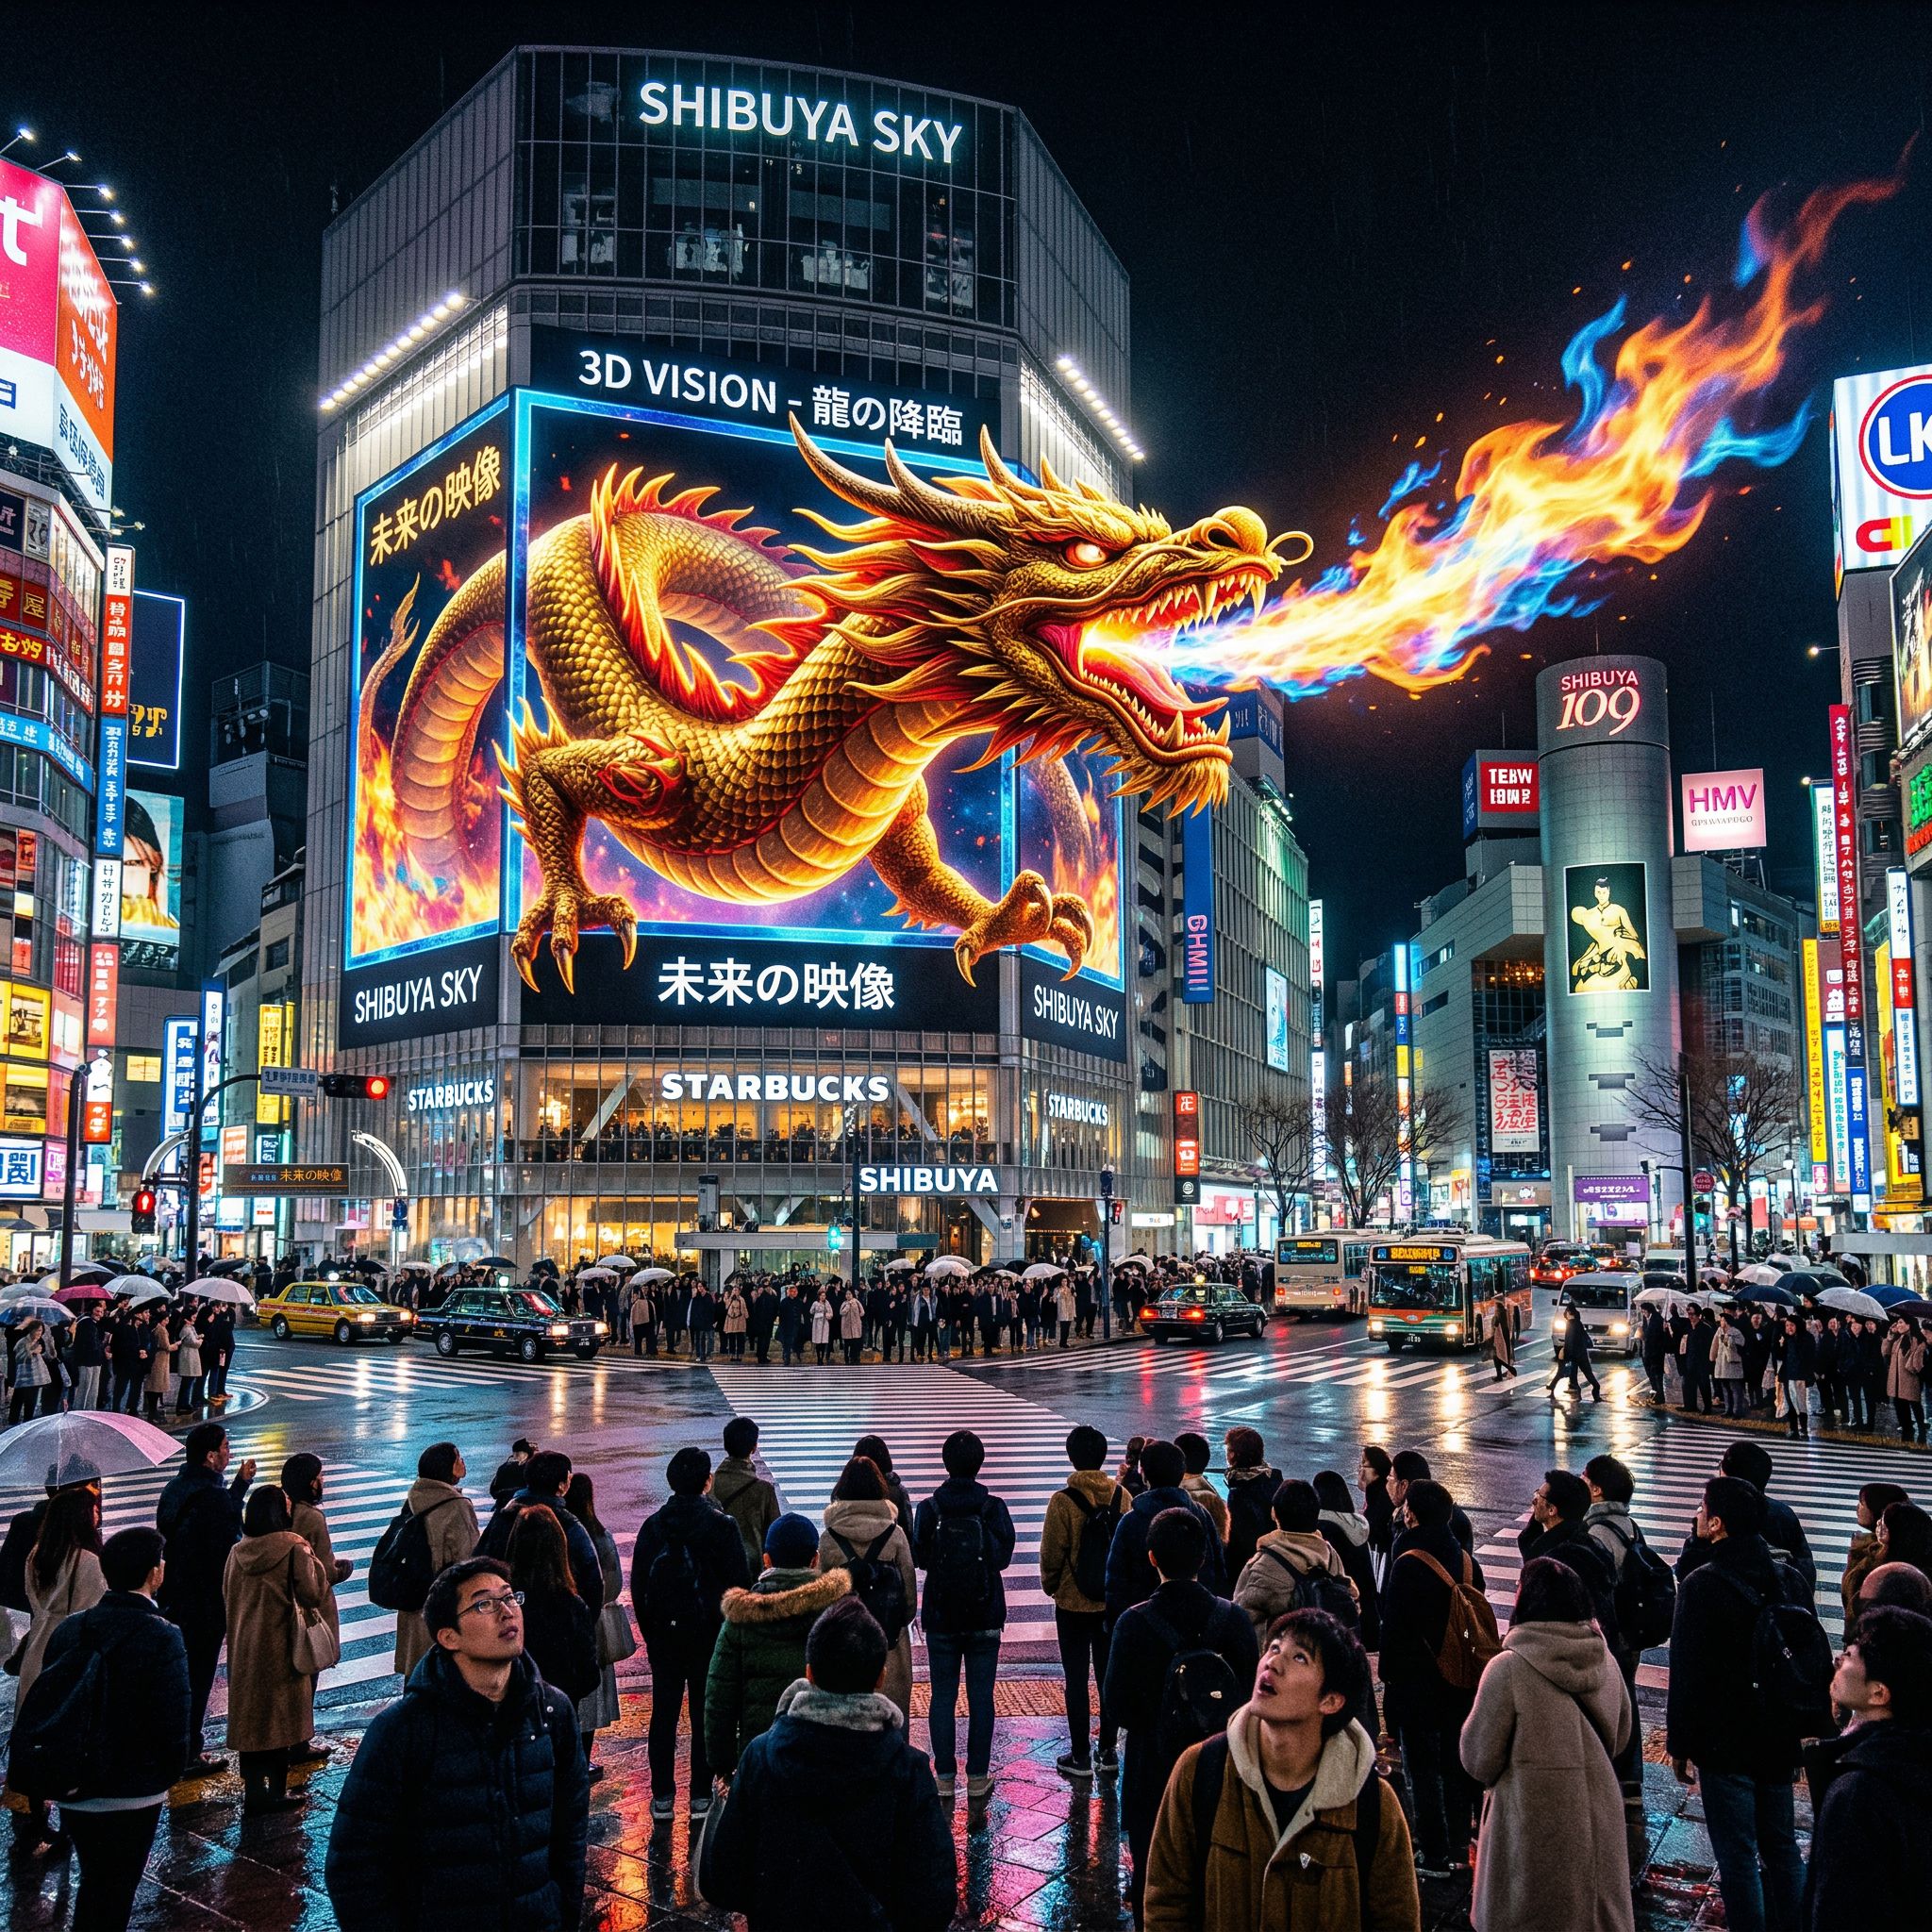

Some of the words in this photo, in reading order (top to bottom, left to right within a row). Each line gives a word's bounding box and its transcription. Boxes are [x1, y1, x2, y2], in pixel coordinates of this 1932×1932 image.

[639, 82, 859, 146] SHIBUYA
[873, 110, 963, 164] SKY
[578, 350, 632, 389] 3D
[642, 359, 776, 414] VISION
[811, 385, 963, 445] 龍の降臨
[370, 445, 501, 566] 未来の映像
[1560, 670, 1639, 691] SHIBUYA
[1556, 686, 1641, 737] 109
[1689, 782, 1757, 813] HMV
[355, 976, 435, 1024] SHIBUYA
[440, 964, 483, 1008] SKY
[658, 956, 895, 1011] 未来の映像
[1033, 984, 1092, 1030] SHIBUYA
[1094, 1005, 1119, 1041] SKY
[408, 1078, 494, 1112] STARBUCKS
[661, 1073, 890, 1103] STARBUCKS
[1048, 1094, 1109, 1127] STARBUCKS
[859, 1167, 999, 1193] SHIBUYA
